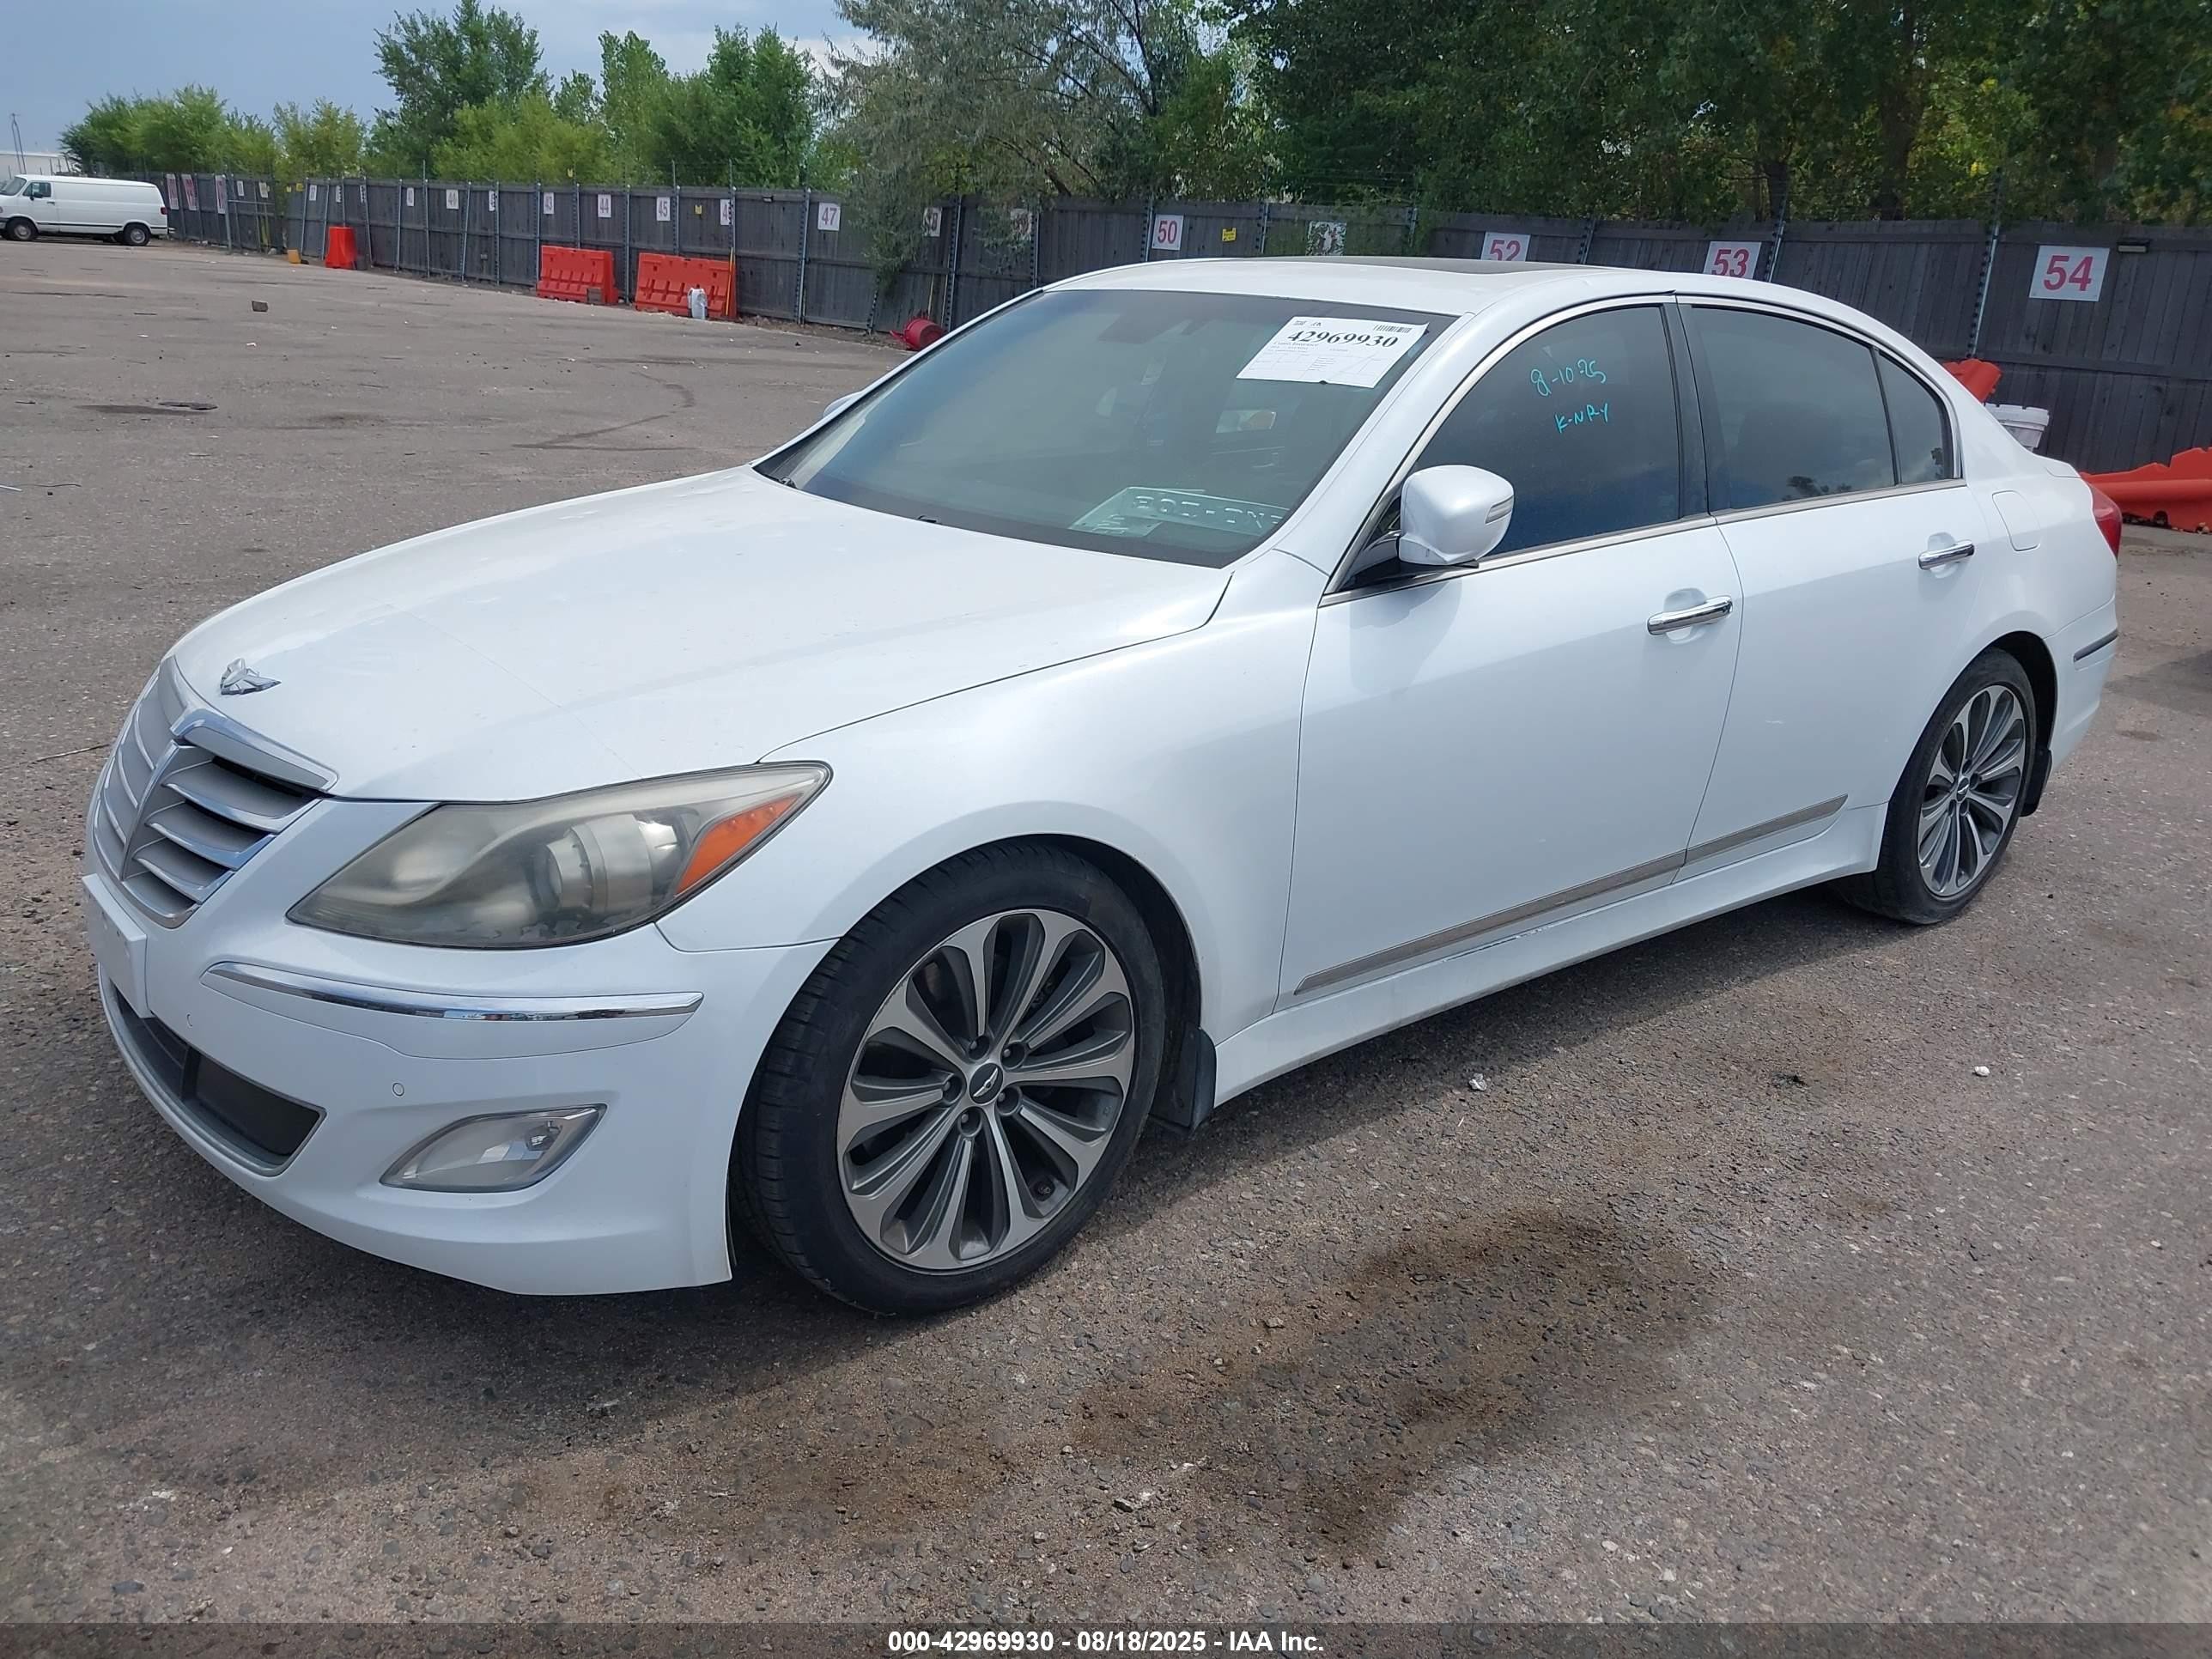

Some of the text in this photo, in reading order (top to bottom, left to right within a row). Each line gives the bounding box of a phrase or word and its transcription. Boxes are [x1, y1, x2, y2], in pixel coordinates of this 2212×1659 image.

[599, 198, 610, 213] 44
[659, 200, 668, 216] 45
[821, 207, 837, 226] 47
[1157, 219, 1178, 245] 50
[1489, 239, 1522, 262] 52
[1711, 249, 1750, 279] 53
[2043, 254, 2094, 292] 54
[1287, 330, 1399, 349] 42969930
